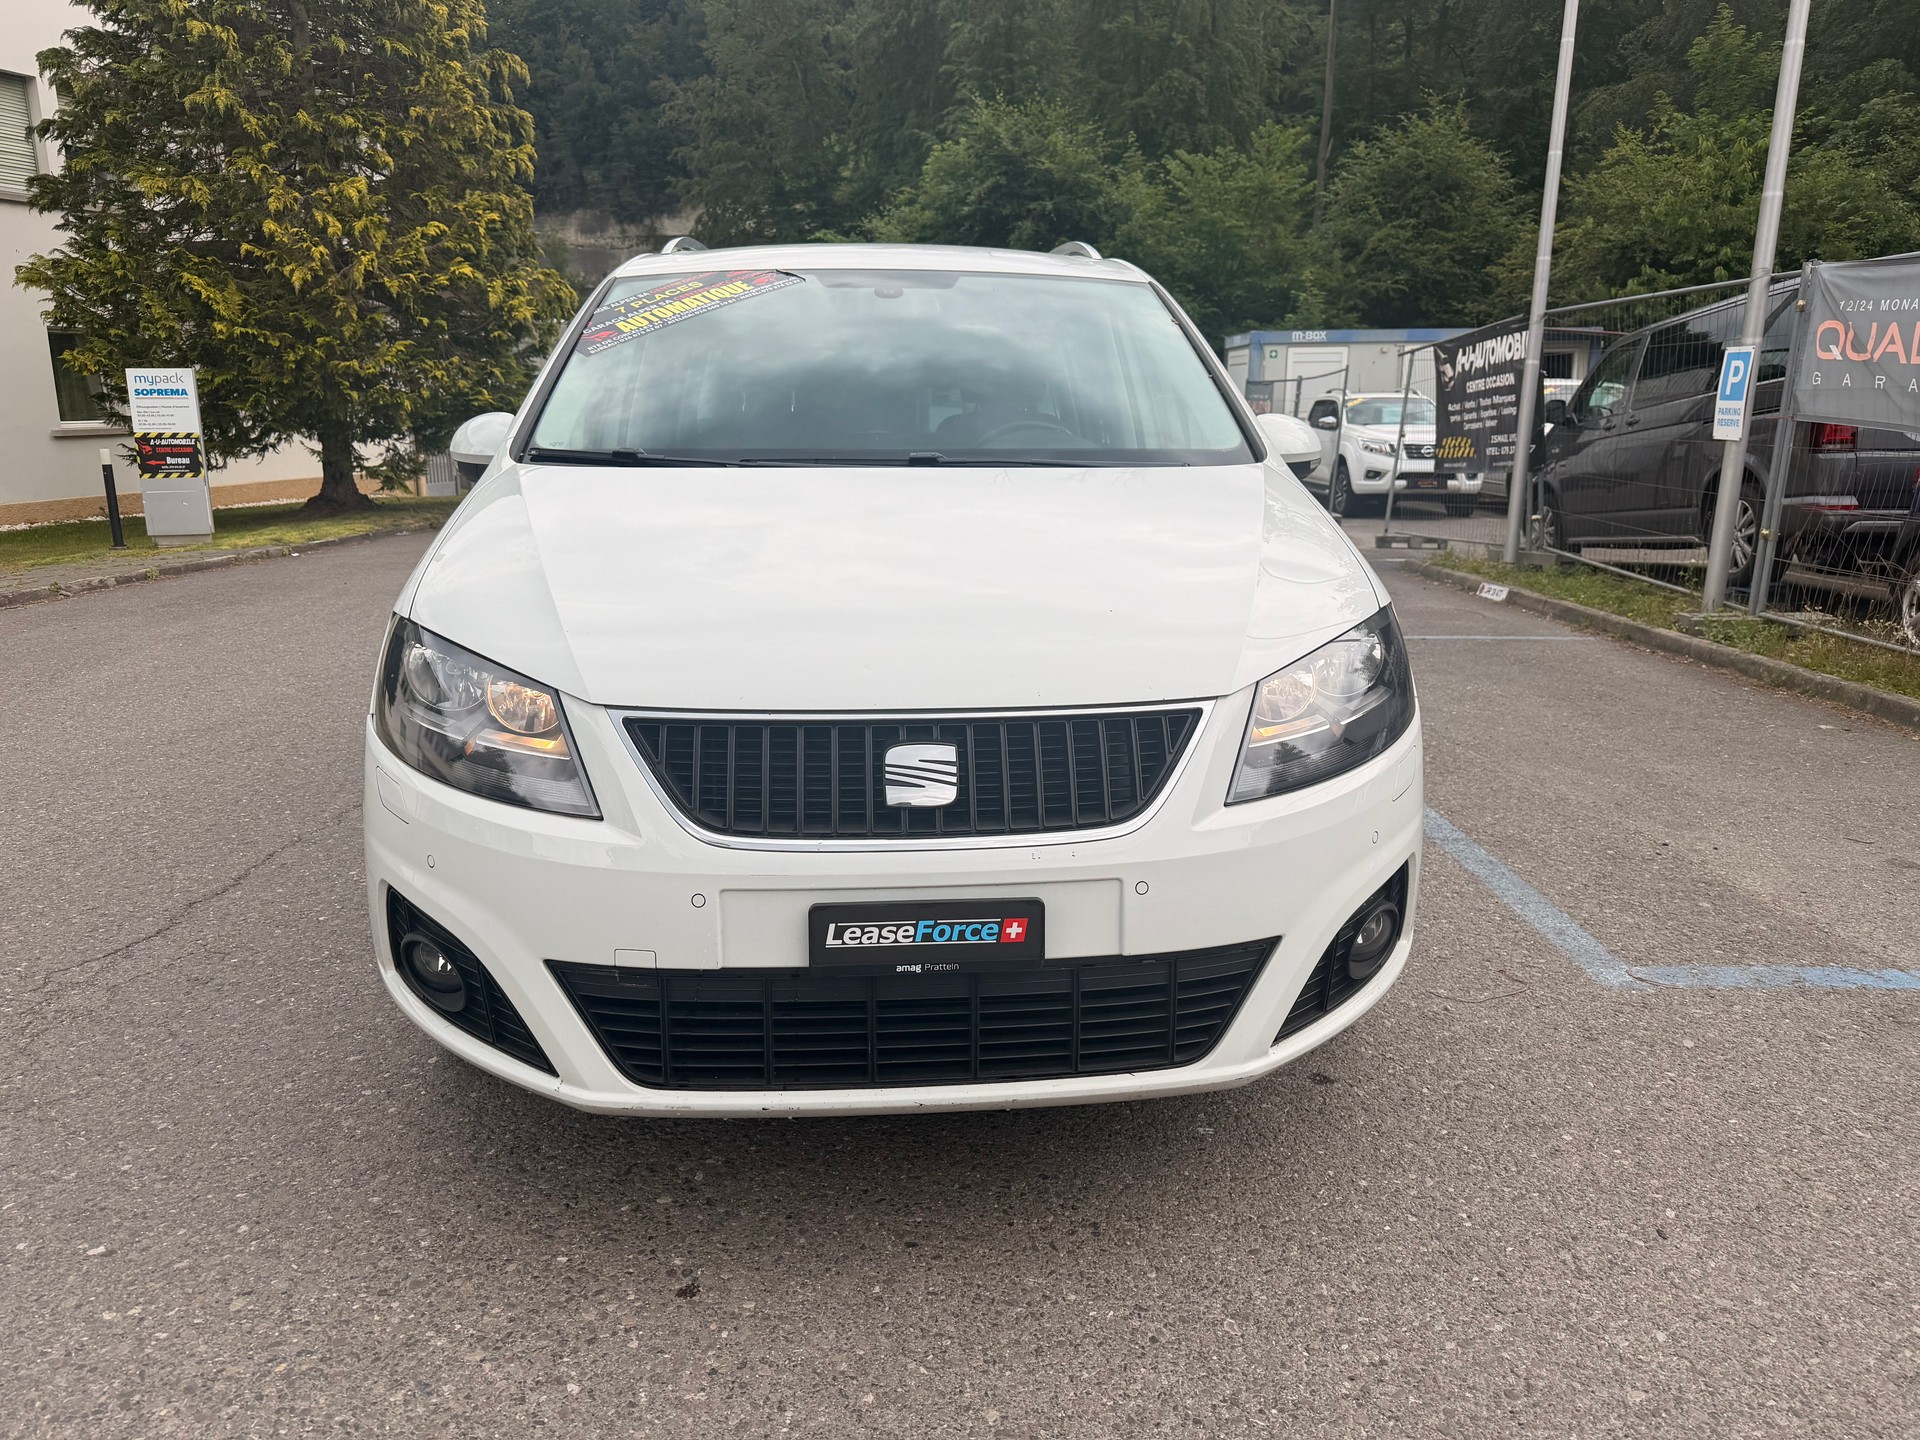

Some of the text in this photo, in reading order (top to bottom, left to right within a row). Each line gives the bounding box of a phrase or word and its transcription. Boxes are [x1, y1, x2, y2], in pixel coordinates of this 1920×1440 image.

[611, 296, 637, 308] ALPER
[614, 281, 704, 314] 7 PLACES
[614, 280, 755, 333] AUTOMATIQUE
[1839, 298, 1919, 312] 12/24 MONA
[583, 315, 626, 334] GARAGE
[628, 304, 657, 318] ALPER
[658, 299, 674, 307] SA
[1816, 319, 1920, 364] QUAL
[1455, 330, 1530, 379] A-U-AUTOMOBI
[134, 372, 184, 386] mypack
[1466, 372, 1515, 394] CENTRE OCCASION
[1725, 360, 1745, 395] P
[1812, 371, 1919, 393] GARA
[134, 388, 189, 397] SOPREMA
[1492, 394, 1516, 404] Marques
[1717, 407, 1741, 416] PARKING
[1717, 418, 1740, 427] RESERVE
[166, 456, 190, 464] Bureau
[825, 920, 999, 946] LeaseForce
[896, 962, 960, 973] amag Pratteln
